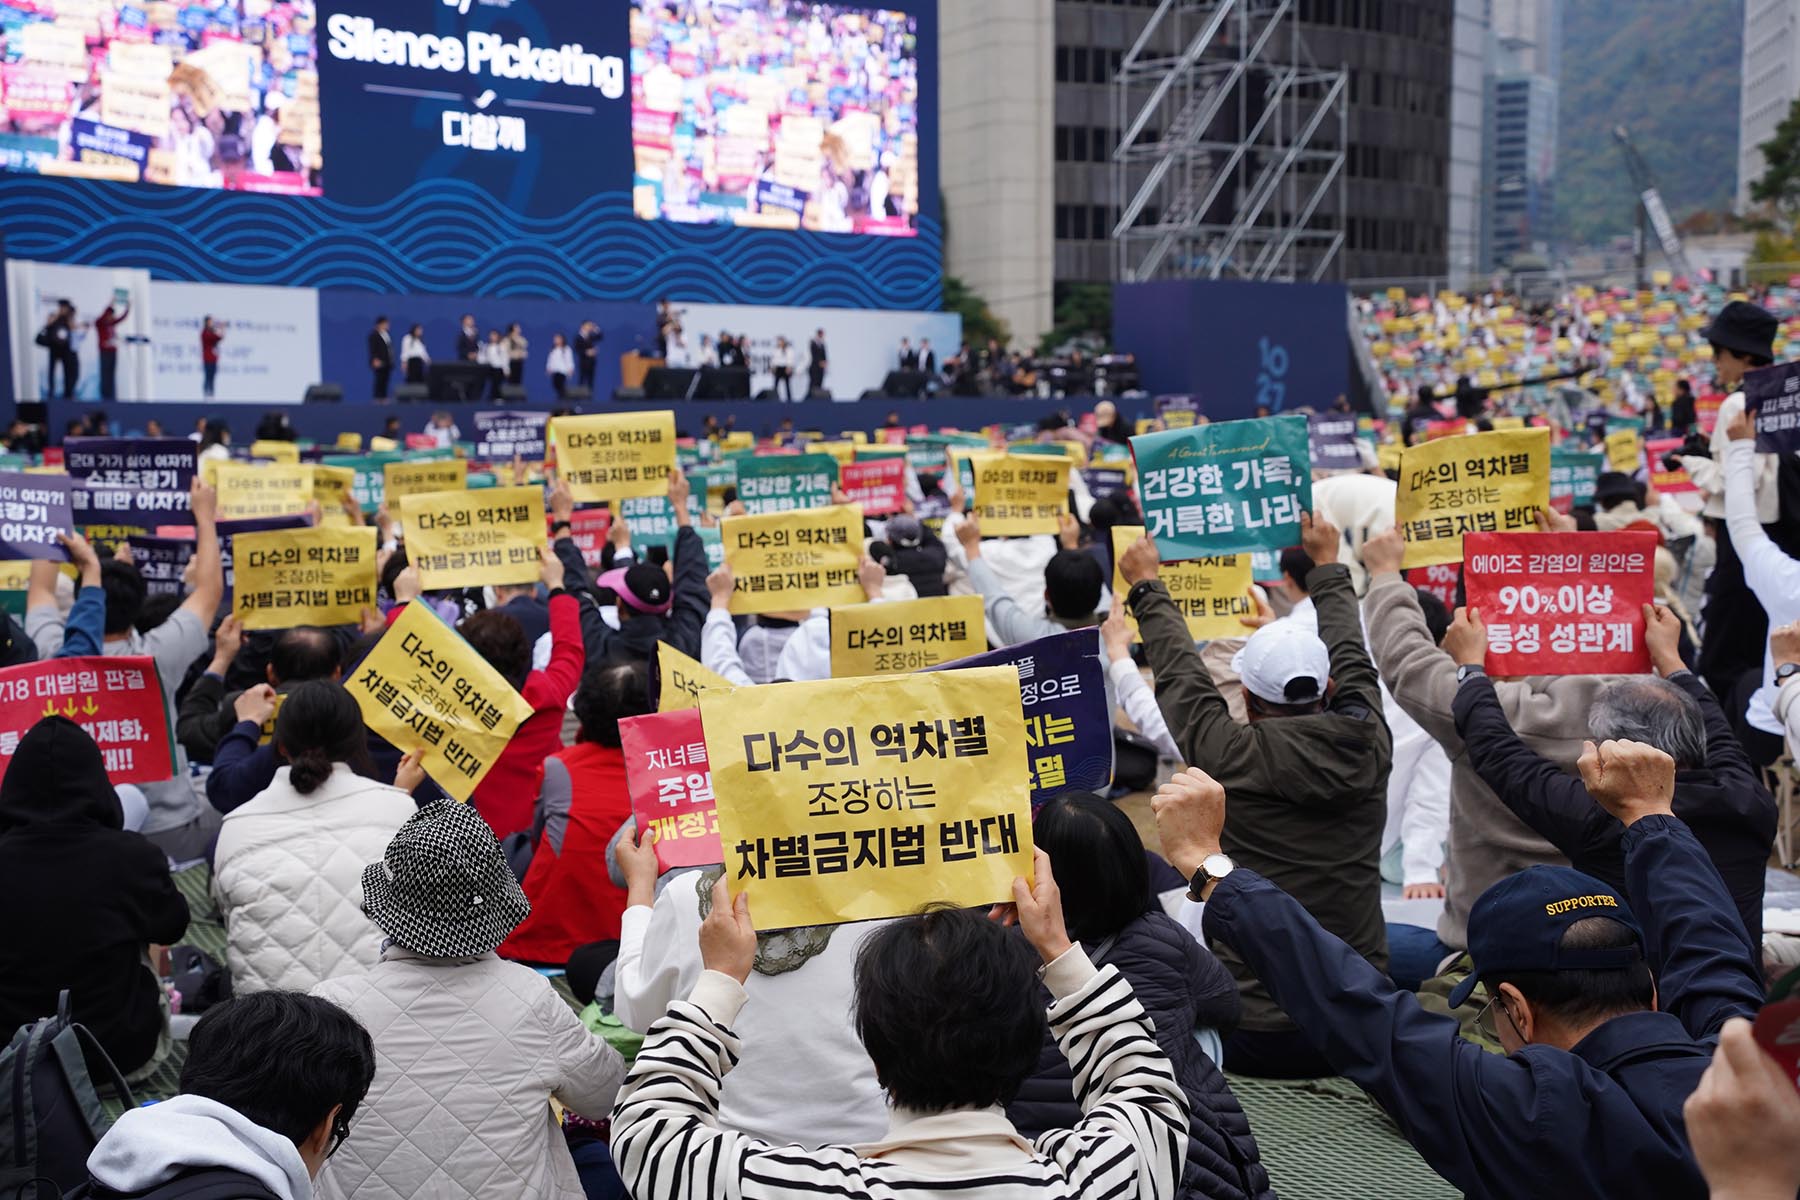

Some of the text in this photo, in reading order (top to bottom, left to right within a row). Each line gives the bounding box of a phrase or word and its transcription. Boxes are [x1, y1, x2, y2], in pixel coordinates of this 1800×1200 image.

[327, 13, 625, 99] Silence Picketing
[442, 110, 526, 151] 다함께
[568, 429, 662, 448] 다수의 역차별
[85, 470, 177, 489] 스포츠경기
[1143, 455, 1303, 501] 건강한 가족,
[1410, 461, 1458, 492] 다수의
[1465, 453, 1530, 479] 역차별
[21, 489, 65, 506] 여자?!
[740, 475, 791, 497] 건강한
[94, 491, 132, 510] 때만
[1429, 486, 1502, 511] 조장하는
[0, 501, 48, 522] 경기
[418, 505, 530, 530] 다수의 역차별
[1147, 502, 1235, 538] 거룩한
[447, 530, 507, 547] 조장하는
[738, 526, 848, 549] 다수의 역차별
[249, 546, 360, 568] 다수의 역차별
[416, 549, 502, 571] 차별금지법
[764, 551, 825, 569] 조장하는
[1472, 552, 1645, 574] 에이즈 감염의 원인은
[273, 568, 335, 585] 조장하는
[733, 571, 820, 593] 차별금지법
[240, 587, 371, 610] 차별금지법 반대
[1213, 596, 1250, 617] 반대
[1499, 584, 1614, 615] 90%이상
[848, 620, 967, 649] 다수의 역차별
[1487, 622, 1633, 654] 동성 성관계
[874, 650, 939, 672] 조장하는
[35, 670, 99, 697] 대법원
[104, 669, 145, 692] 판결
[400, 631, 503, 731] 다수의 역차별
[406, 674, 463, 729] 조장하는
[359, 667, 482, 779] 차별금지법 반대
[743, 715, 989, 773] 다수의 역차별
[807, 775, 936, 817] 조장하는
[735, 813, 1020, 880] 차별금지법 반대
[1545, 894, 1619, 916] SUPPORTER
